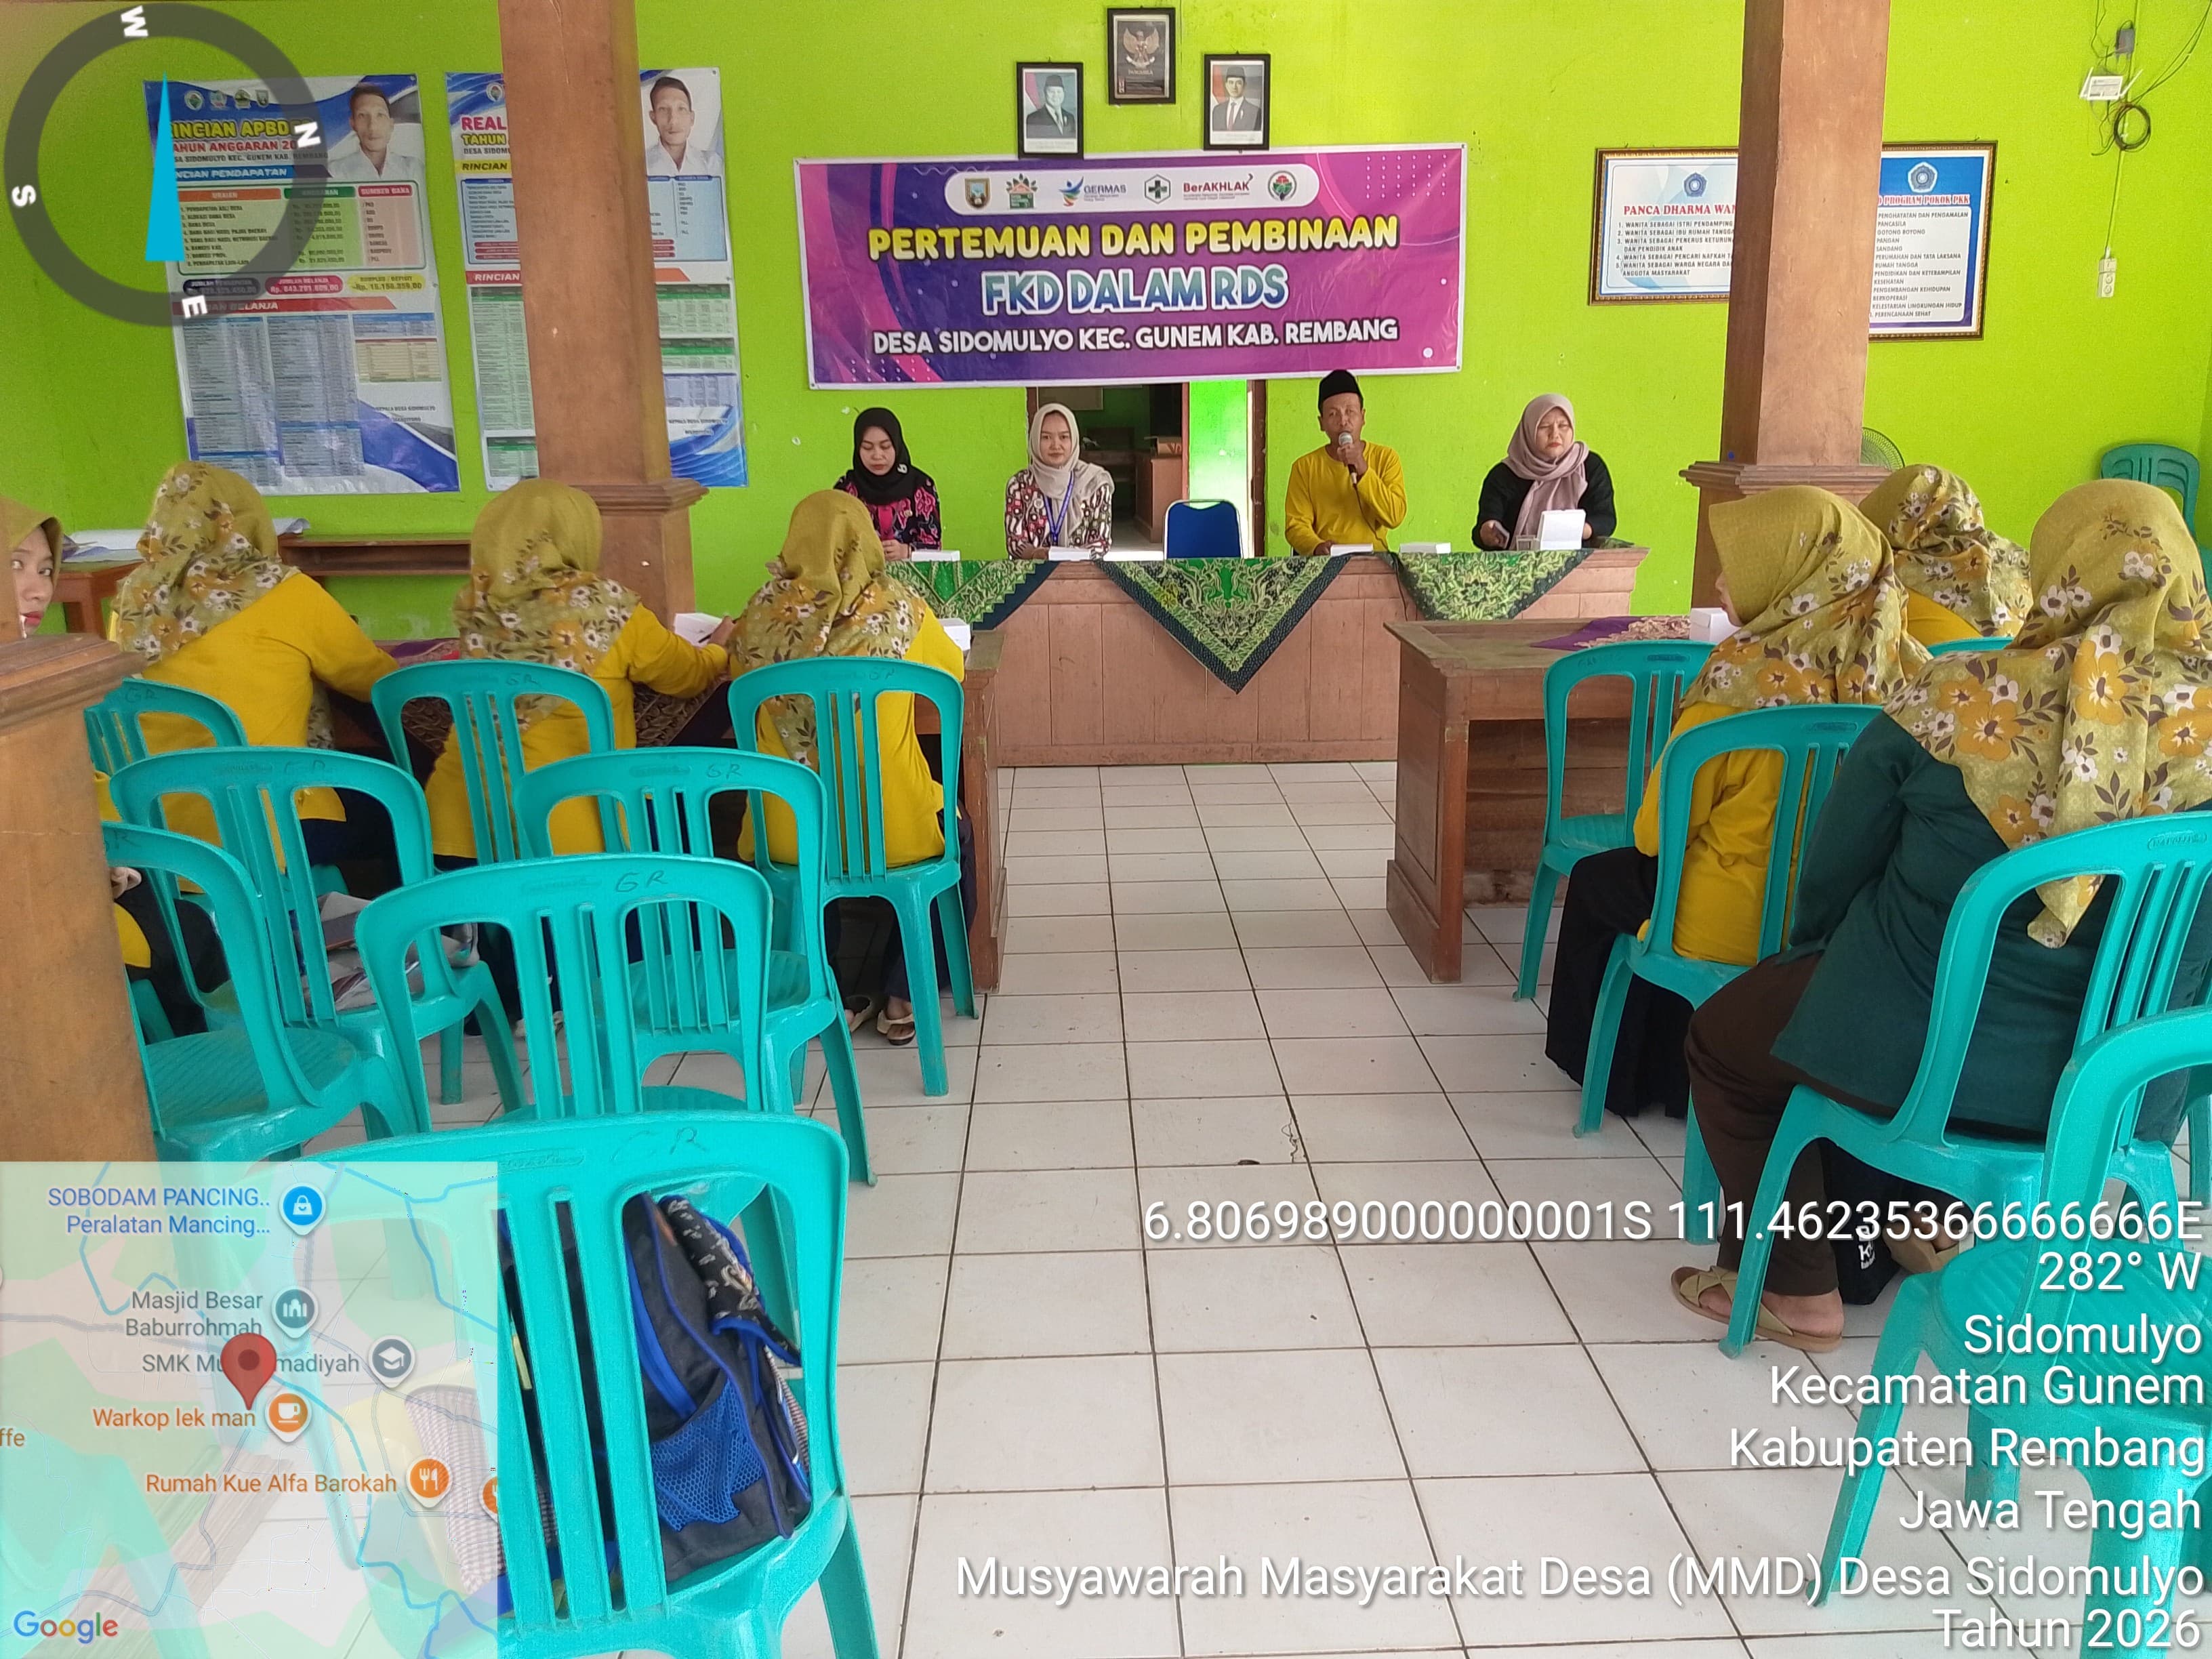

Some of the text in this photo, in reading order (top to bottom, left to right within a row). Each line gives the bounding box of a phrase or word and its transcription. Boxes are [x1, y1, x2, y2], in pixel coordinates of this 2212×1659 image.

[171, 121, 237, 138] INCIAN
[462, 117, 507, 130] REAL
[173, 142, 205, 152] AHUN
[209, 140, 278, 152] ANGGARAN
[462, 134, 507, 146] TAHUN
[176, 168, 287, 179] NCIAN PENDAPATAN
[462, 163, 508, 171] RINCIAN
[1084, 184, 1126, 194] GERMAS
[1183, 180, 1251, 193] BerAKHLAK
[1884, 194, 1922, 206] PROGRAM
[1924, 194, 1952, 205] POKOK
[1952, 193, 1971, 205] PKK
[1624, 205, 1711, 216] PANCA DHARMA
[868, 216, 1398, 261] PERTEMUAN DAN PEMBINAAN
[474, 273, 520, 282] RINCIAN
[981, 263, 1288, 316] FKD DALAM RDS
[873, 319, 1398, 354] DESA SIDOMULYO KEC. GUNEM KAB. REMBANG
[615, 869, 669, 893] GR
